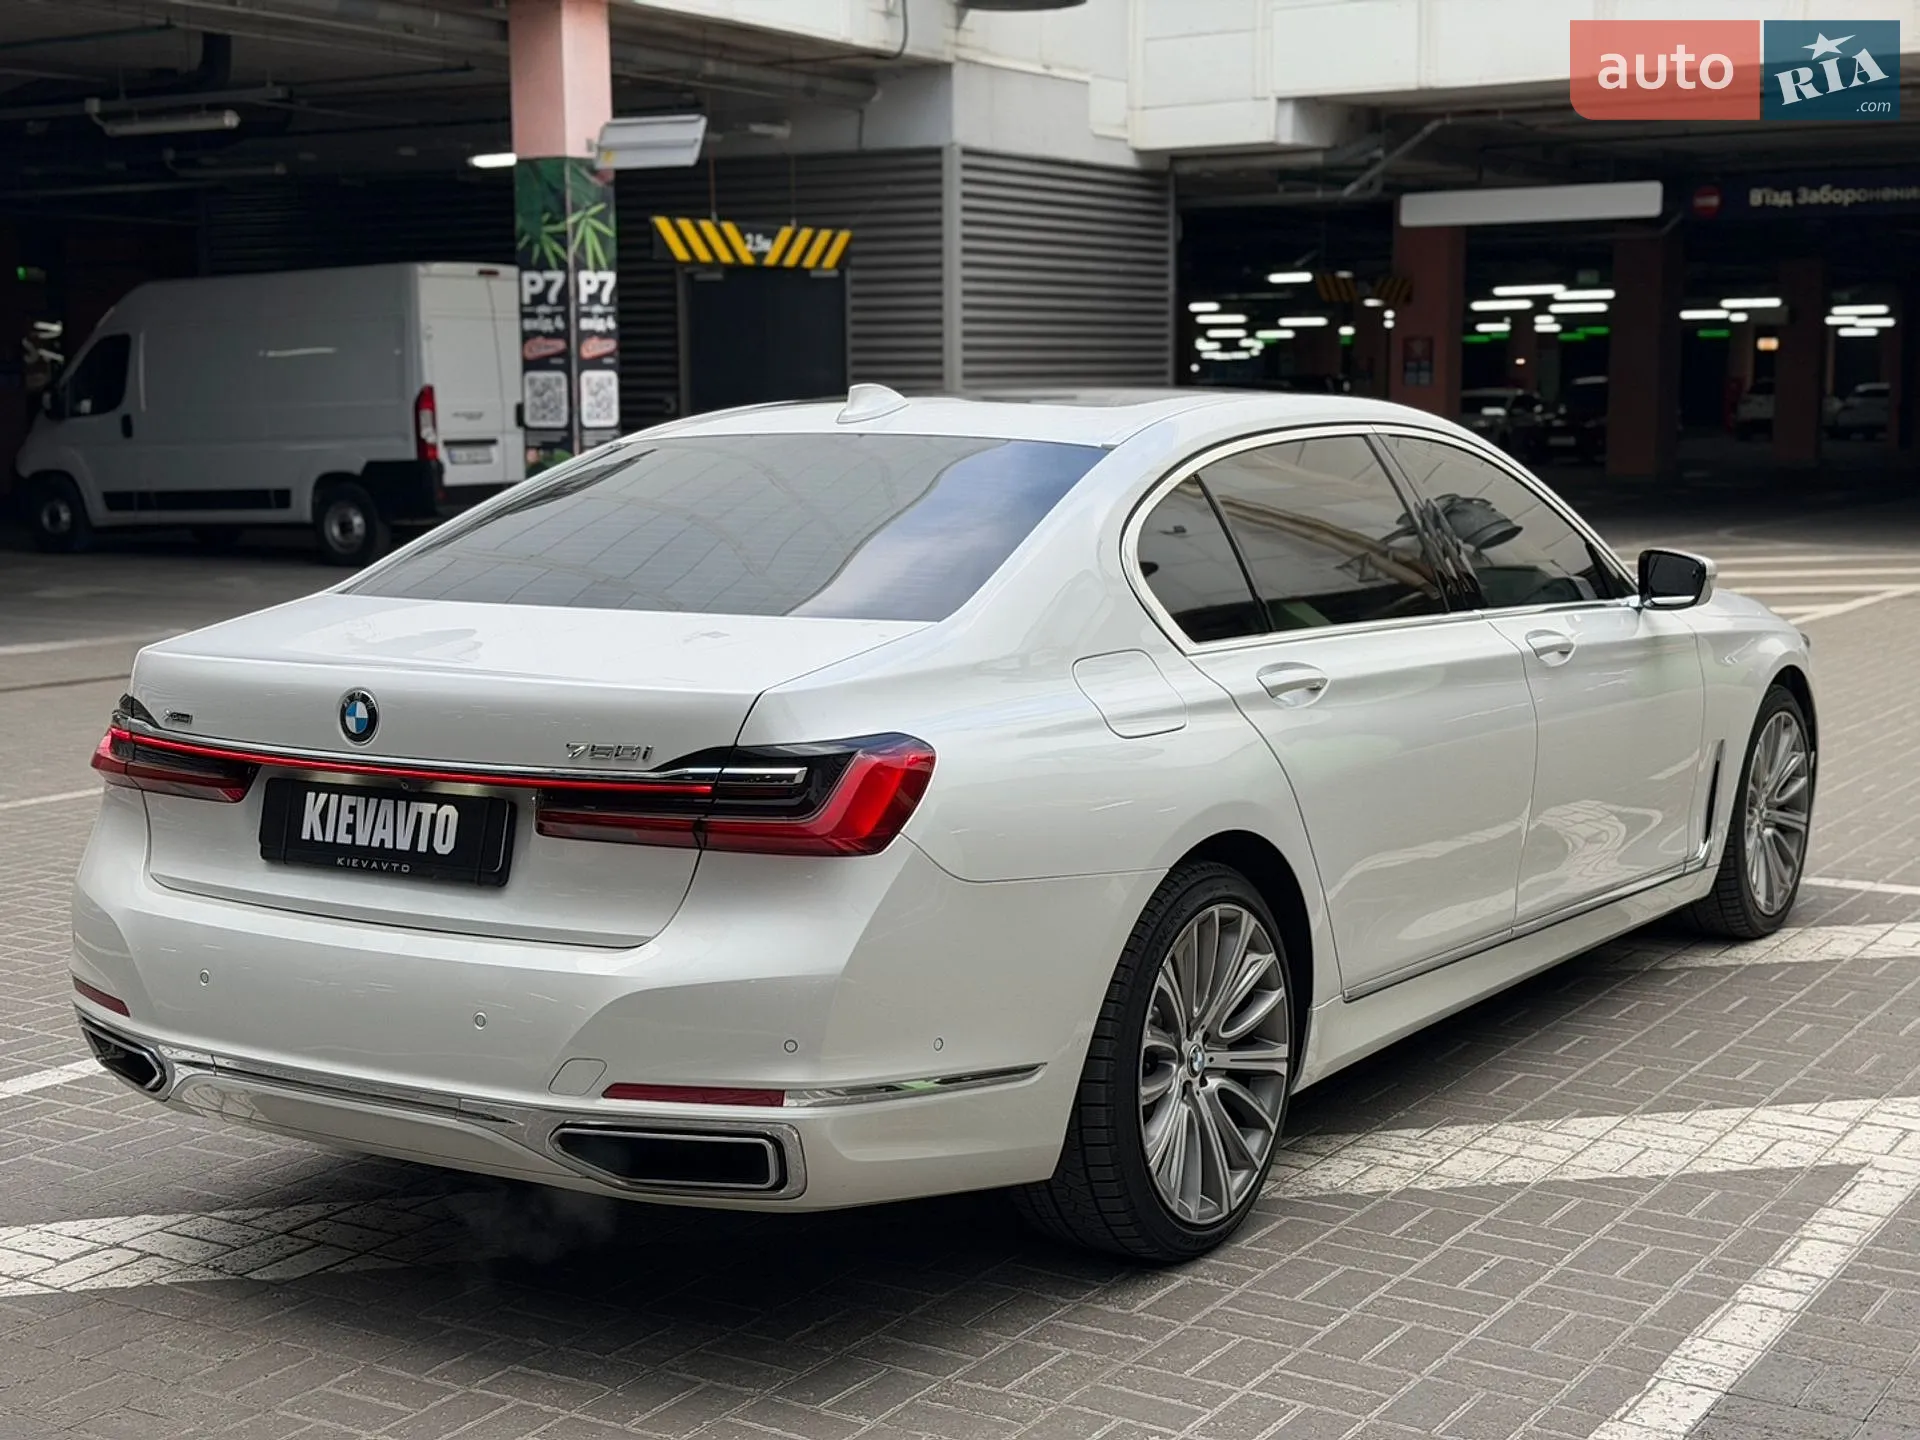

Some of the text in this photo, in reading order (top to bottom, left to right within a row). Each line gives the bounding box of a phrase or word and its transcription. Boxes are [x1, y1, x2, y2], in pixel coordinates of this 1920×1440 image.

[521, 270, 566, 305] P7
[578, 270, 616, 305] P7
[566, 743, 654, 761] 750i
[301, 791, 459, 855] KIEVAVTO
[336, 857, 411, 873] KIEVAVTO
